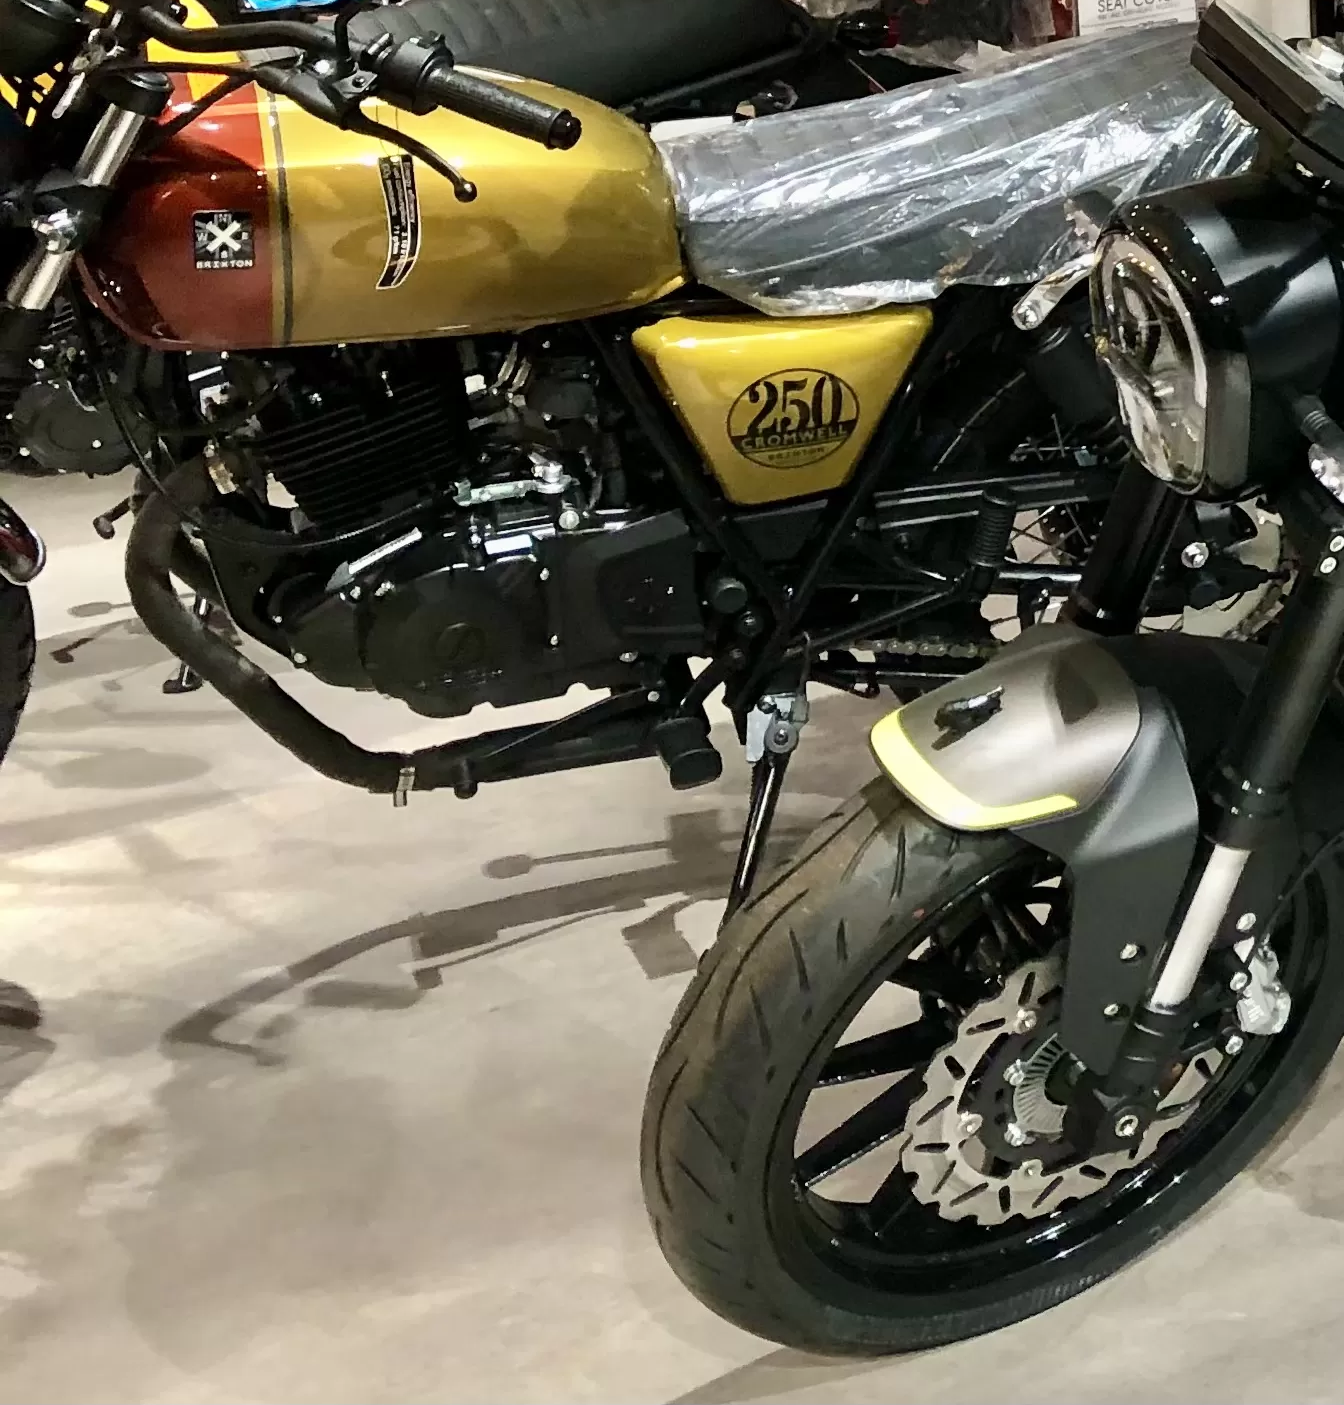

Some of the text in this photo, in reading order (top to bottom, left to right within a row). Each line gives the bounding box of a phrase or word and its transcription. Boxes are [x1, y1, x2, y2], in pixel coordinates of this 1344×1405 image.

[196, 259, 253, 269] BRIXTON
[748, 376, 843, 433] 250
[741, 424, 848, 450] CROMWELL
